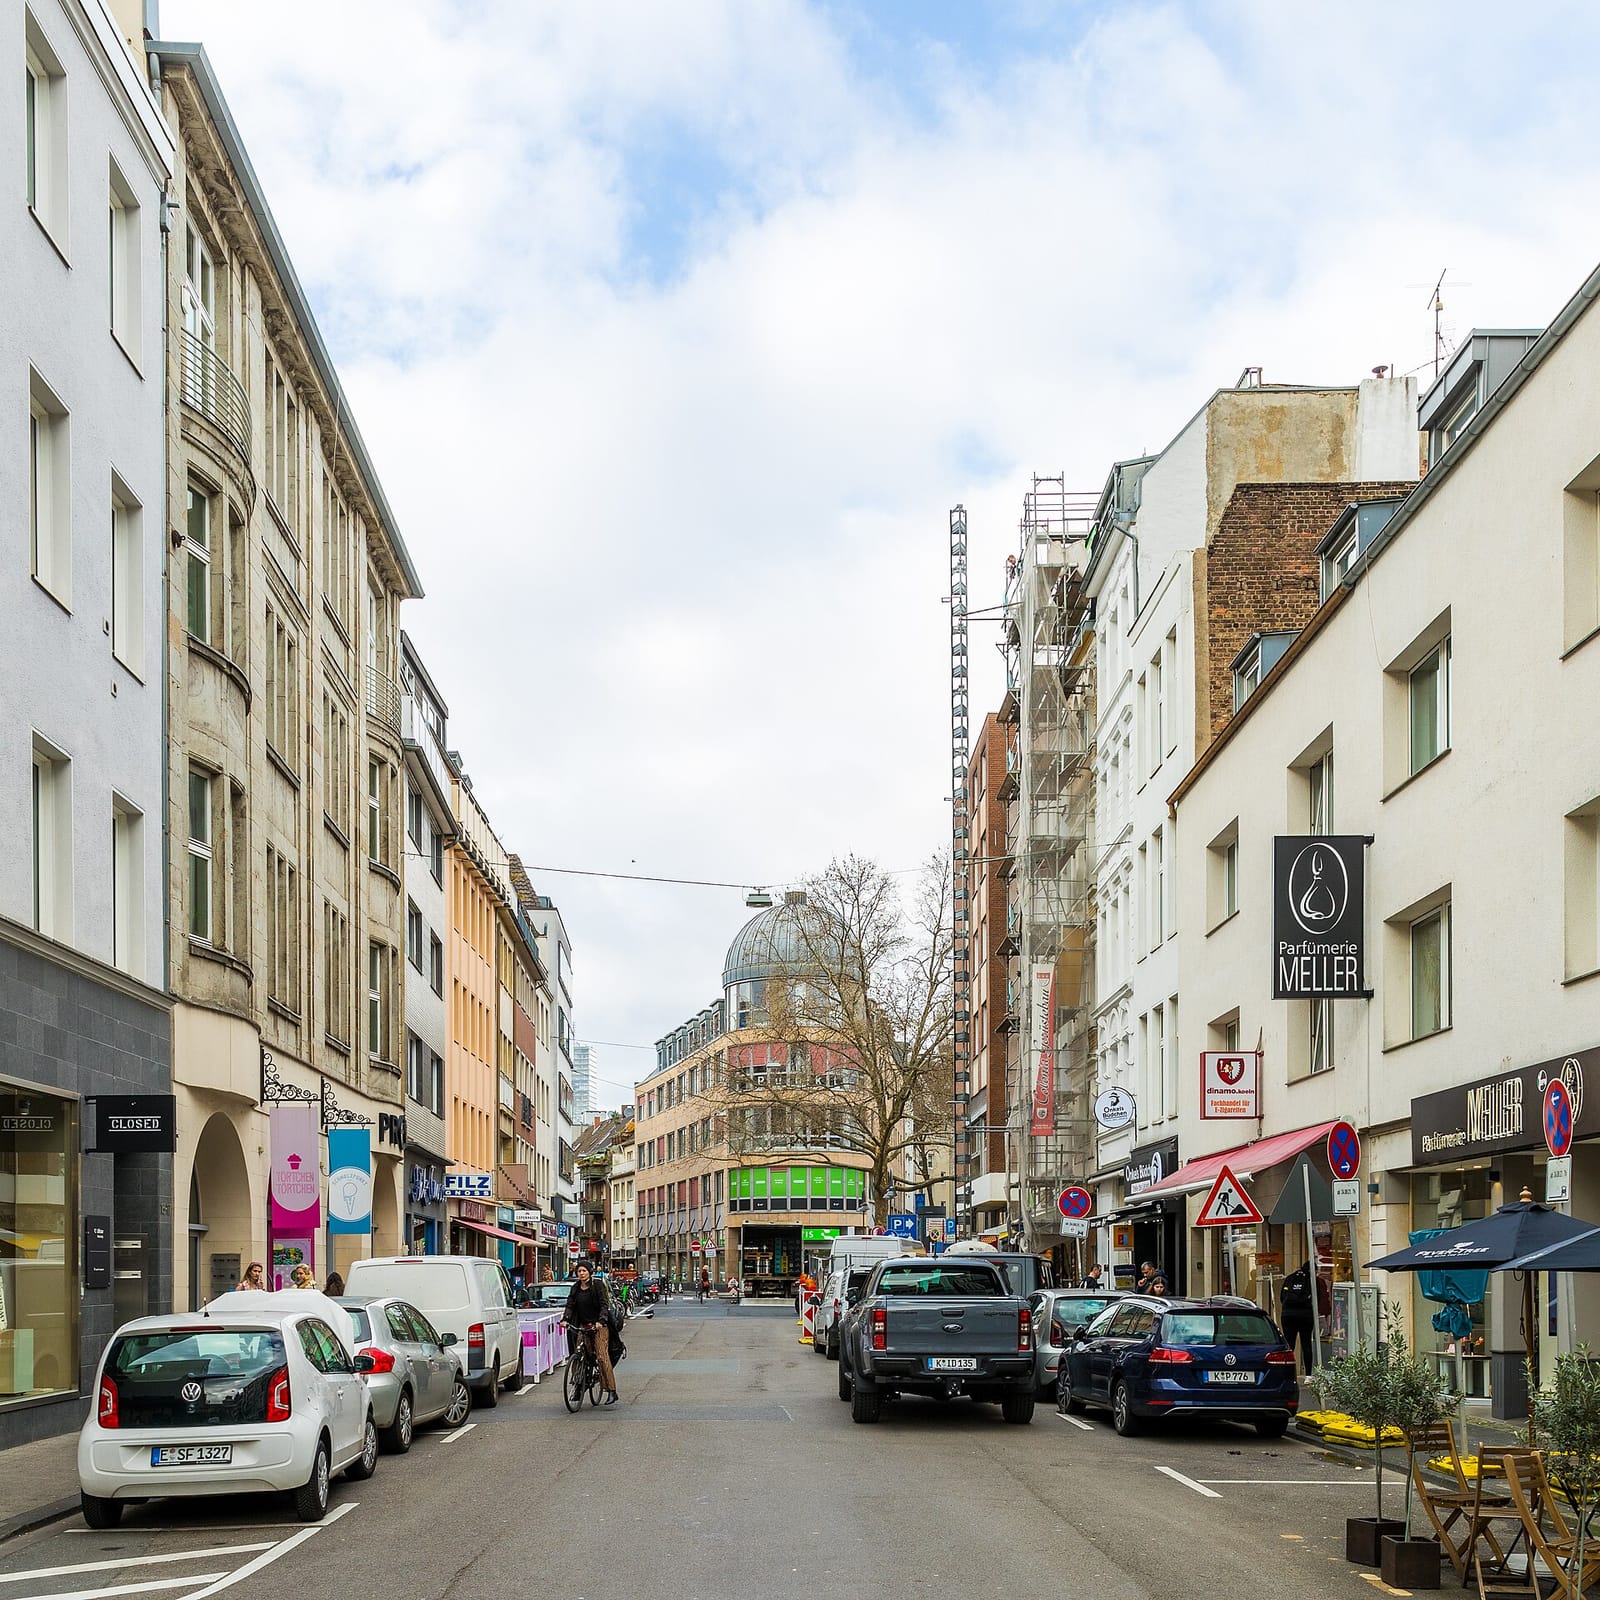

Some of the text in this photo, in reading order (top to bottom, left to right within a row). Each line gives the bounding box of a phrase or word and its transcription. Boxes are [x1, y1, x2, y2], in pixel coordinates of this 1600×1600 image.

[1279, 940, 1358, 955] Parfümerie
[1279, 956, 1358, 992] MELLER
[1467, 1077, 1523, 1142] MELLER
[111, 1118, 160, 1129] CLOSED
[445, 1176, 490, 1189] FILZ
[894, 1220, 902, 1230] P
[936, 1359, 974, 1368] K ID 135
[1214, 1372, 1220, 1380] K
[1232, 1372, 1249, 1380] 776
[160, 1446, 230, 1461] E SF 1327
